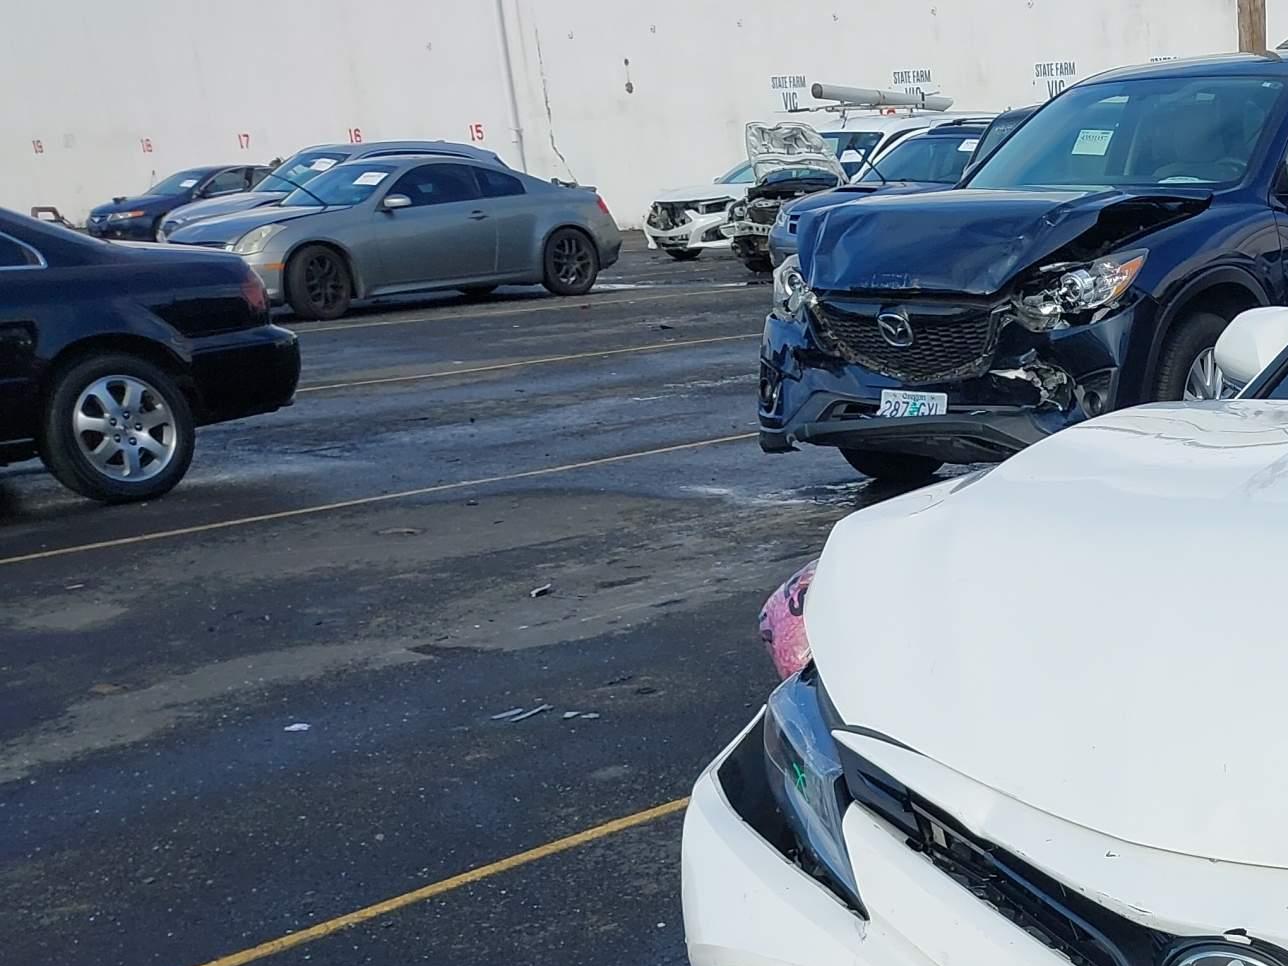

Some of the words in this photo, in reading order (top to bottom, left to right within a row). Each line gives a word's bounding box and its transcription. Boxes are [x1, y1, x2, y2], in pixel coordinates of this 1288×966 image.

[893, 71, 911, 85] STATE
[912, 69, 931, 83] FARM
[1035, 63, 1055, 77] STATE
[1055, 62, 1075, 76] FARM
[771, 77, 788, 89] STATE
[789, 76, 806, 88] FARM
[782, 92, 798, 111] VIC
[349, 128, 362, 144] 16
[469, 124, 484, 141] 15
[238, 133, 250, 150] 17
[882, 400, 910, 416] 287
